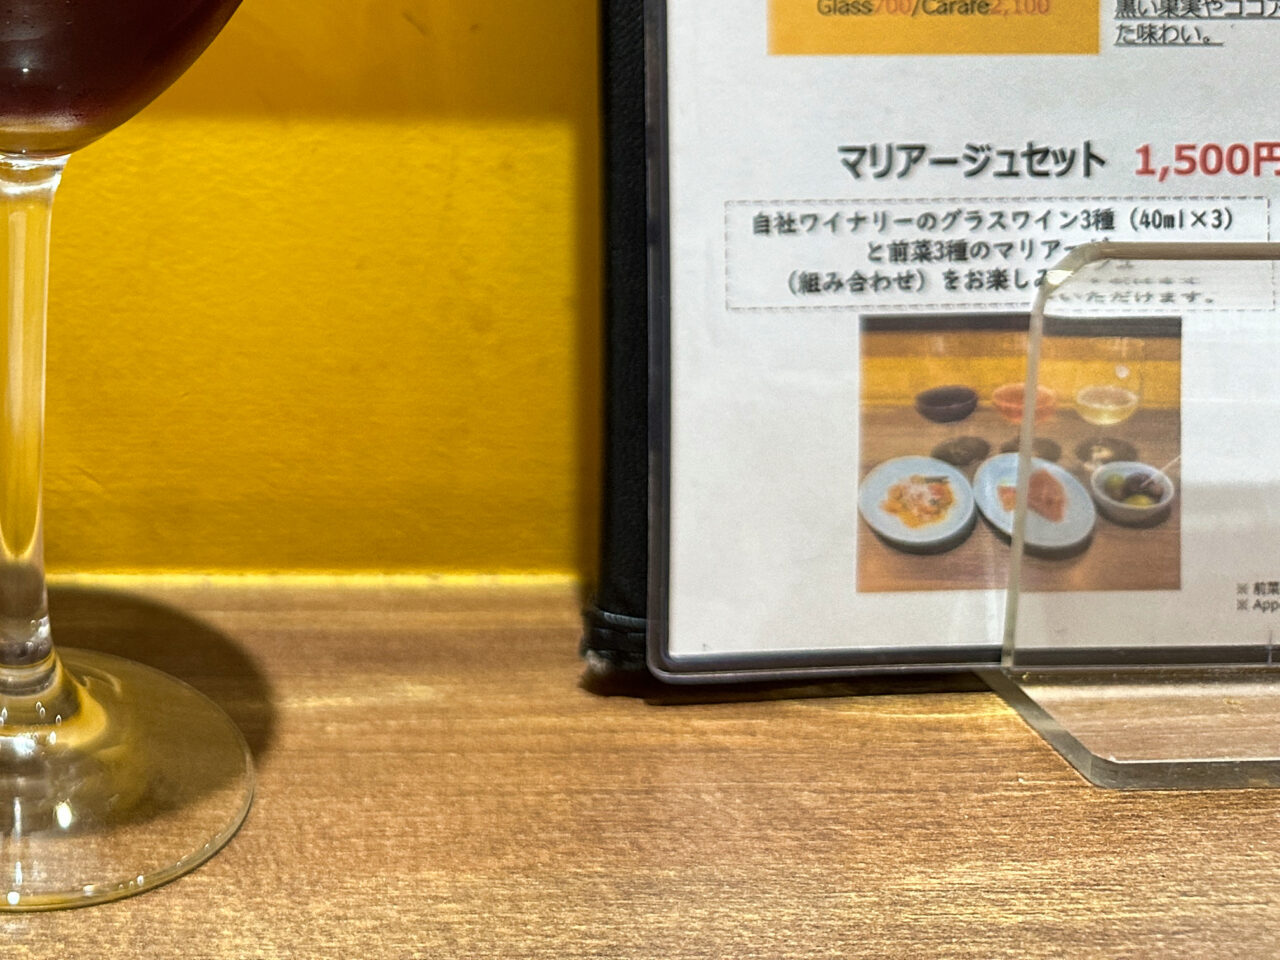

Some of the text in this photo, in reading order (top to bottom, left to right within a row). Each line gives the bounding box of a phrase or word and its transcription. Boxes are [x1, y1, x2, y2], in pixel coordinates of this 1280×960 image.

[1115, 23, 1211, 44] た味わい。
[837, 139, 1280, 183] マリアージュセット 1,500円
